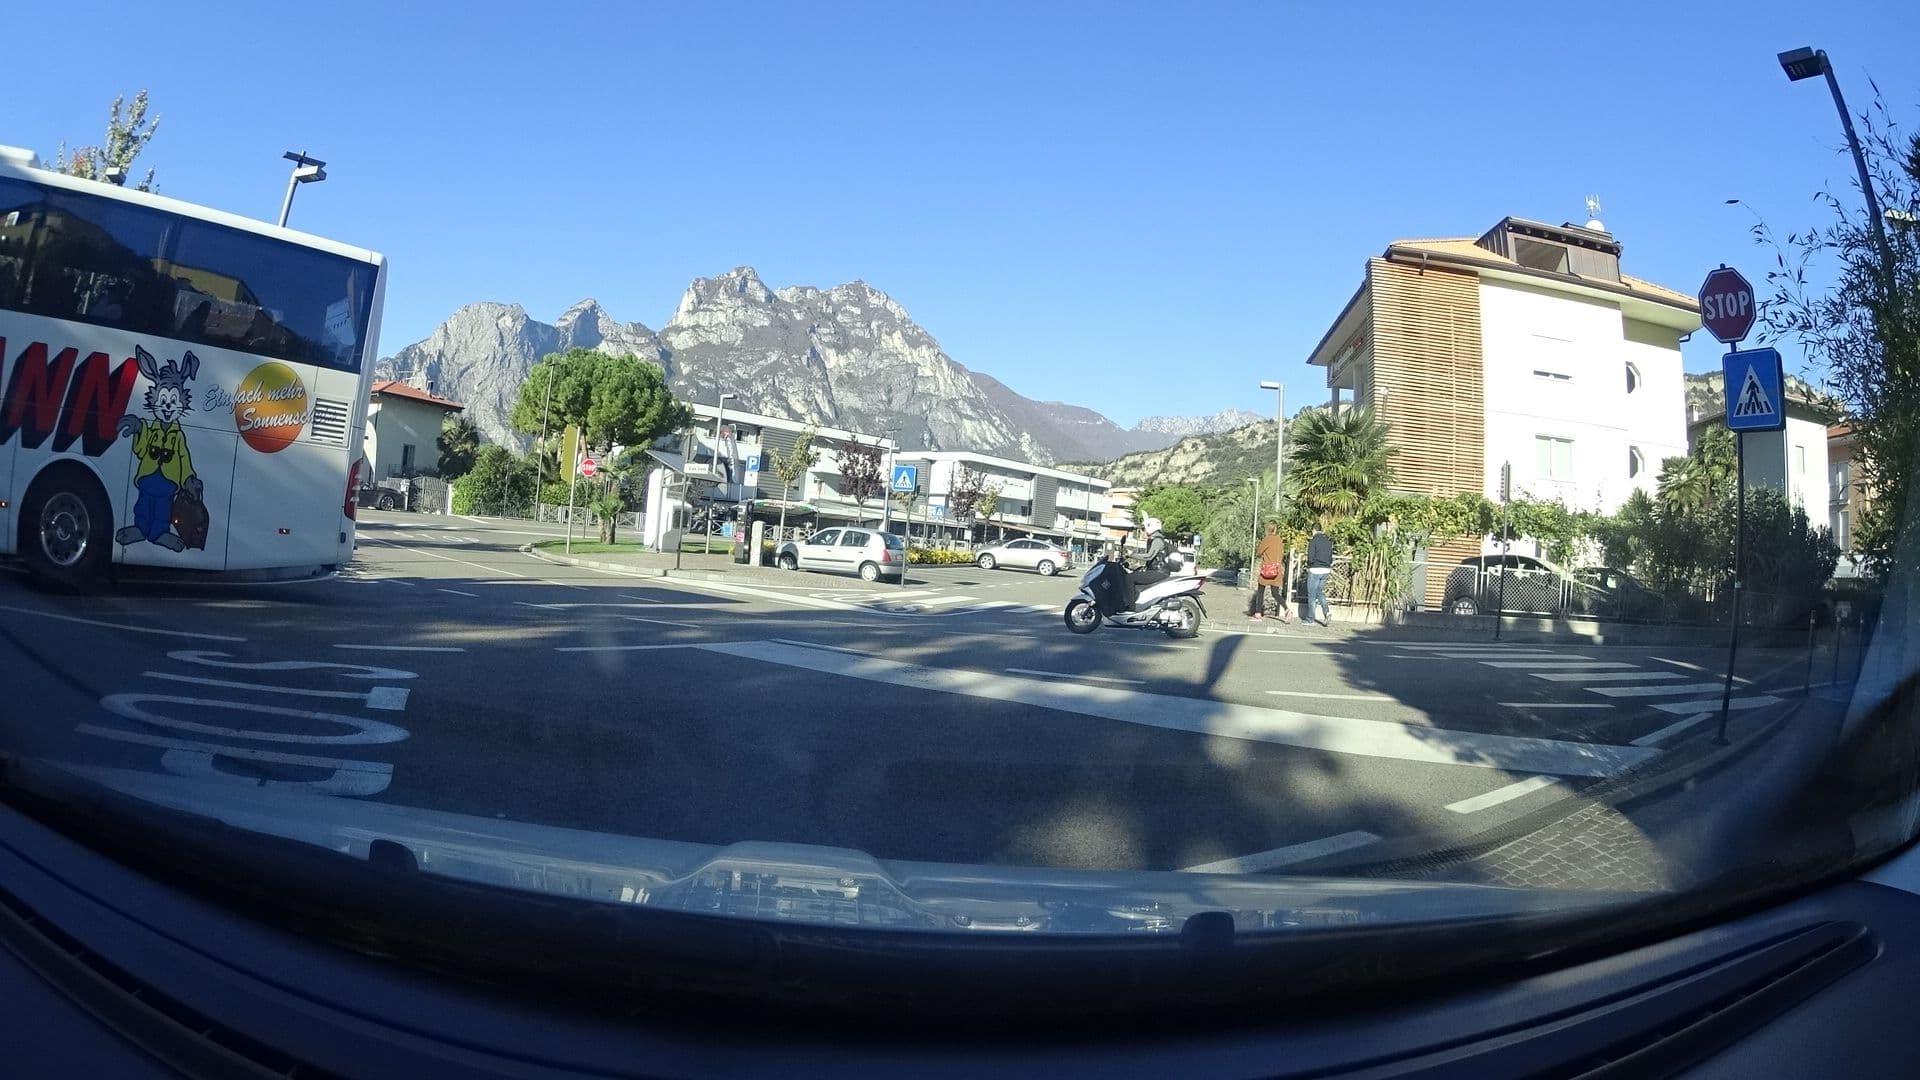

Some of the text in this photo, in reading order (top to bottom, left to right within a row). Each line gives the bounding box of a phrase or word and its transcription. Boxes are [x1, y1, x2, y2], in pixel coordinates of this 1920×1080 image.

[1704, 290, 1750, 320] STOP
[0, 336, 140, 457] NN
[203, 377, 305, 414] Einfach mehr
